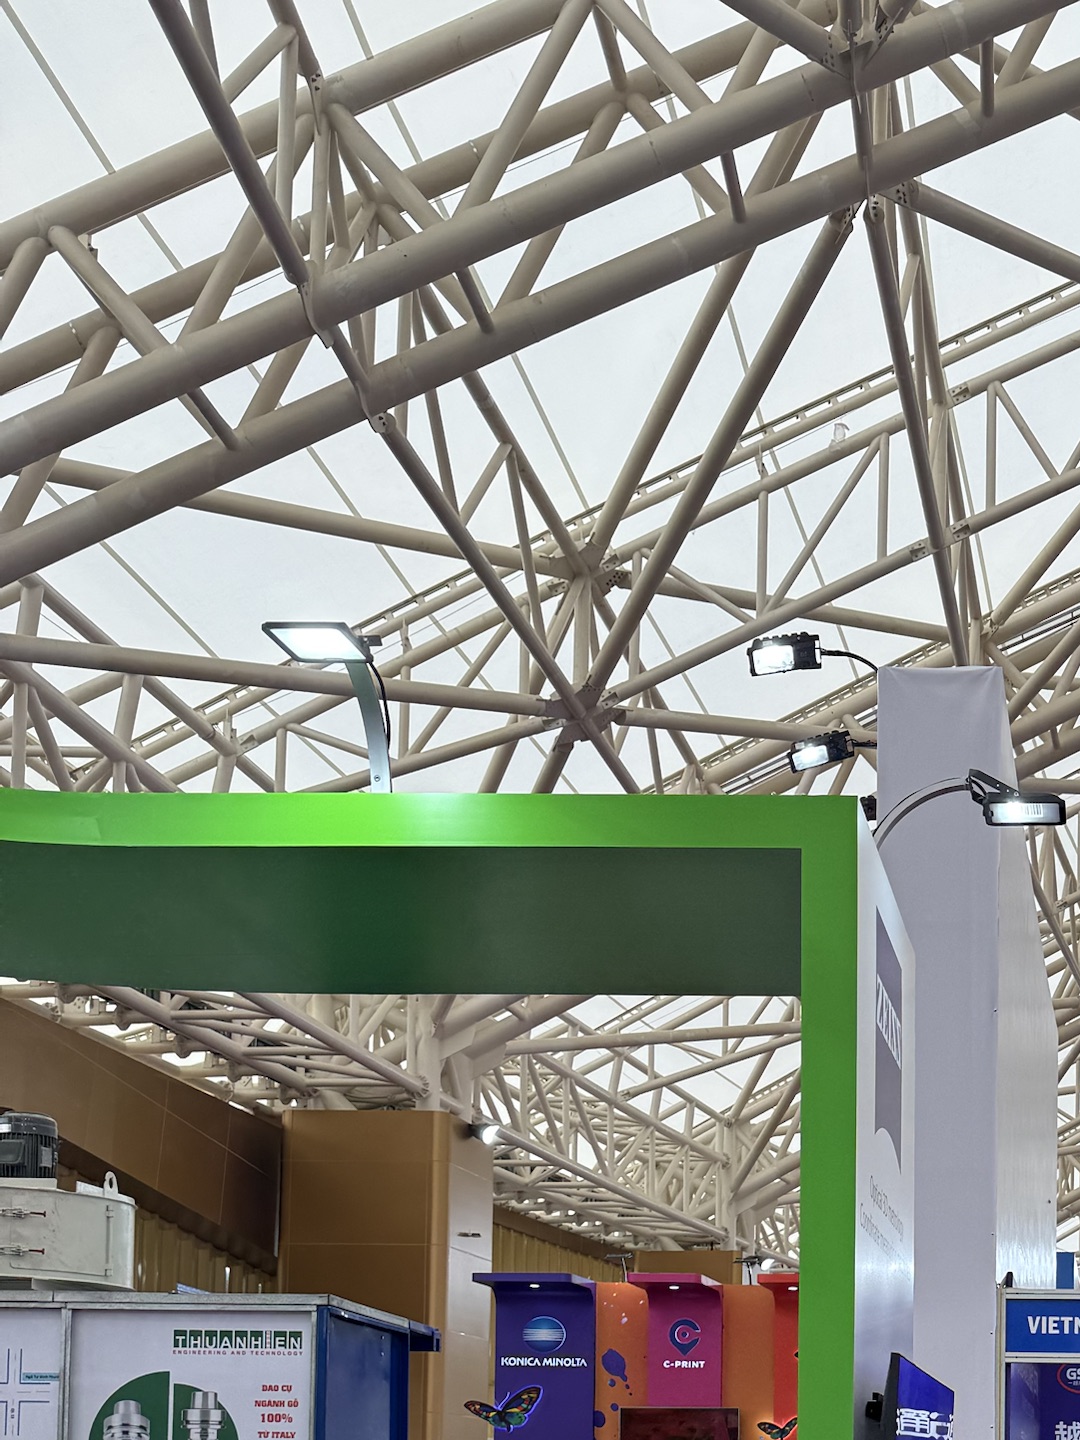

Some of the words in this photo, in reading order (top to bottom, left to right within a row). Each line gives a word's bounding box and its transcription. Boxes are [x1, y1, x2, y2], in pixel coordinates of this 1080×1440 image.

[877, 973, 901, 1070] ZEISS
[500, 1357, 541, 1367] KONICA
[542, 1357, 588, 1367] MINOLTA
[663, 1360, 705, 1369] C-PRINT
[260, 1413, 293, 1423] 100%
